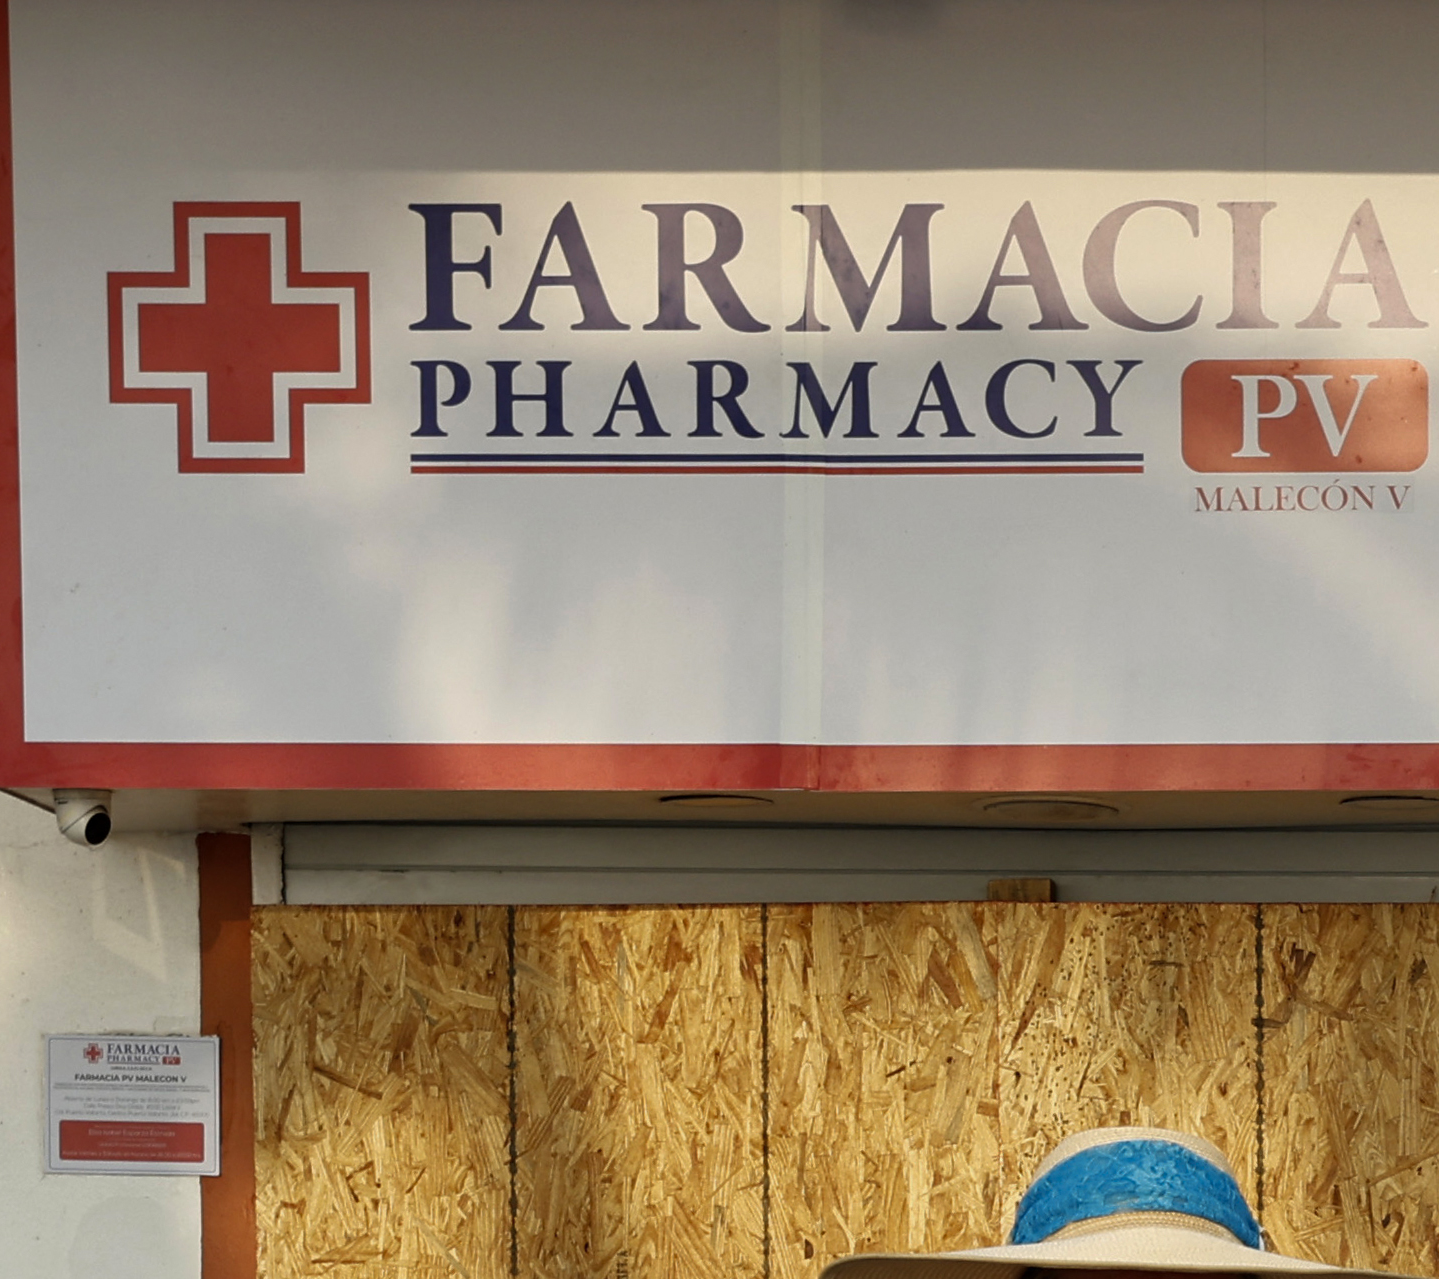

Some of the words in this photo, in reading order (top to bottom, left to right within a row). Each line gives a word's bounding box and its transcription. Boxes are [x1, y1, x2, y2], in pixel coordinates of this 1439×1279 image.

[408, 199, 1430, 333] FARMACIA
[410, 357, 1144, 441] PHARMACY
[1230, 372, 1379, 461] PV
[1193, 479, 1373, 514] MALECÓN
[1383, 485, 1411, 513] V
[106, 1043, 181, 1056] FARMACIA
[74, 1073, 120, 1082] FARMACIA
[122, 1074, 134, 1082] PV
